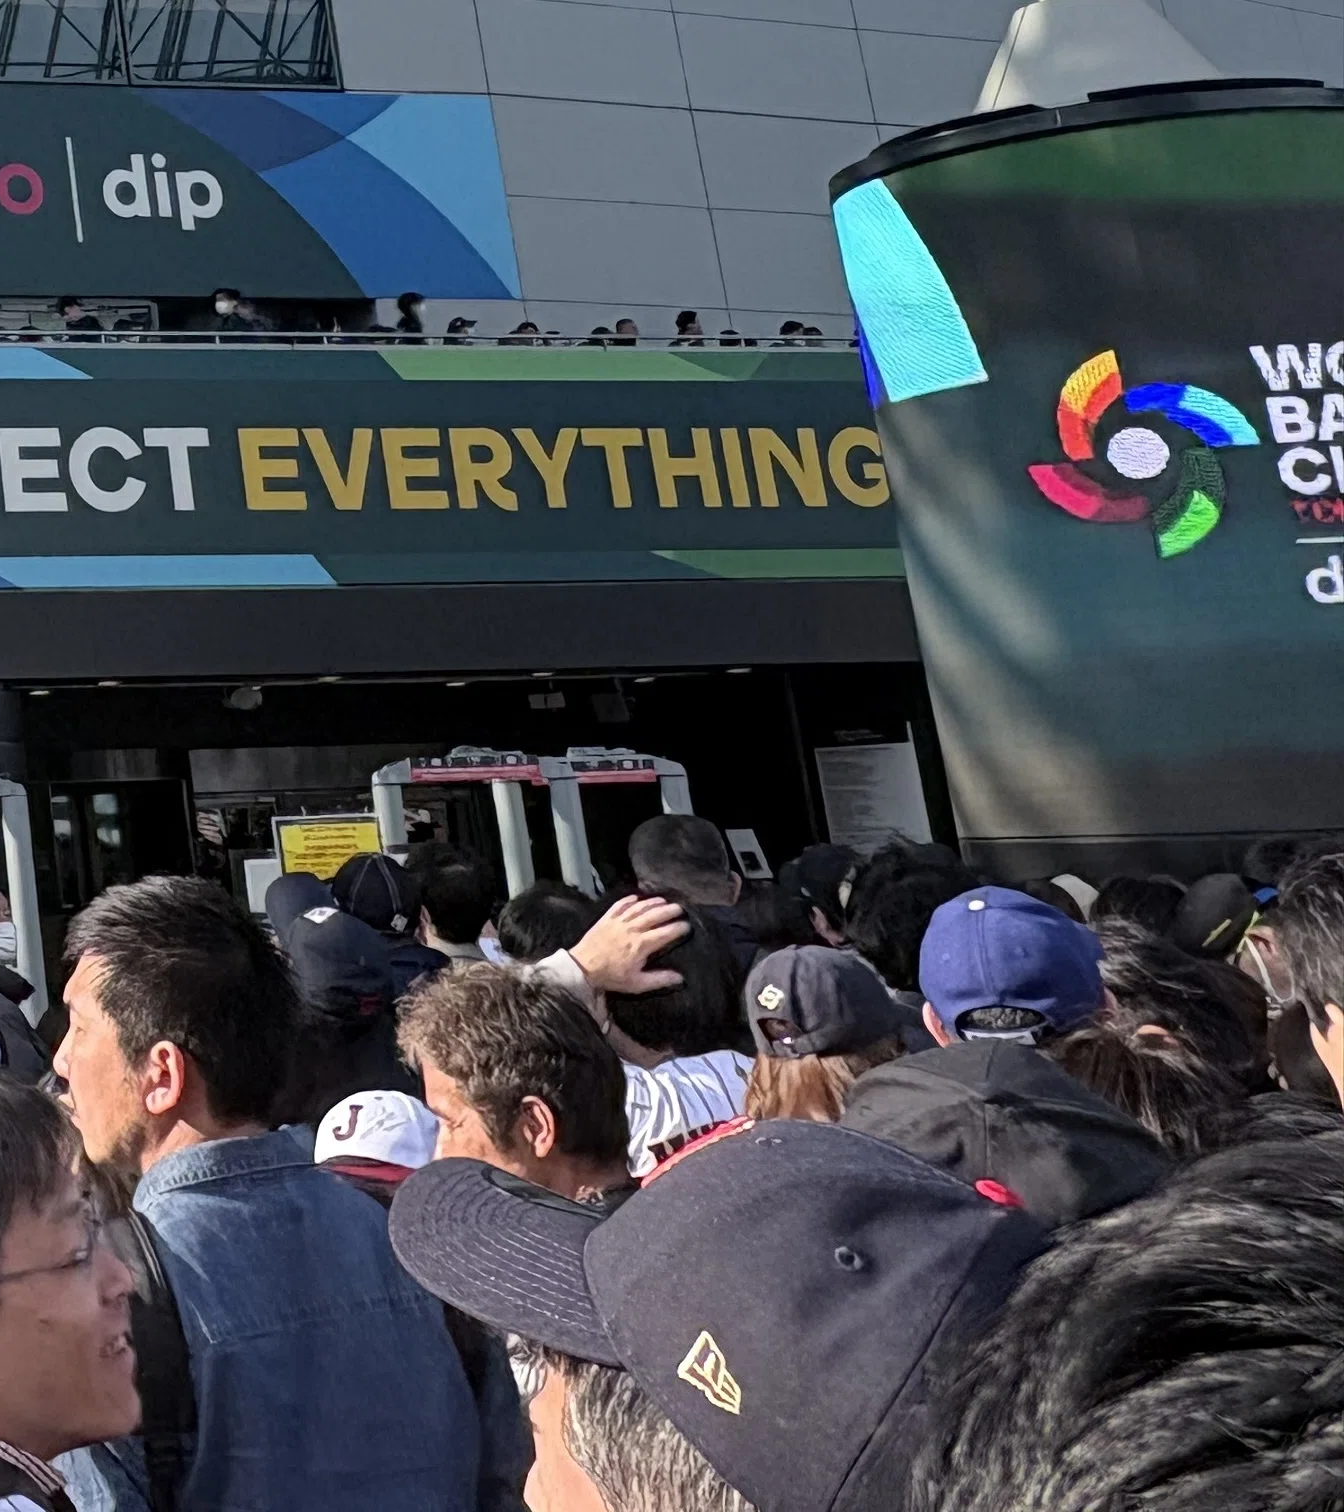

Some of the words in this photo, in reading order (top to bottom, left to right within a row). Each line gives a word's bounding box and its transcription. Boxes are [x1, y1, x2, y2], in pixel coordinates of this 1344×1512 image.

[102, 152, 224, 231] dip
[238, 425, 891, 511] EVERYTHING
[332, 1104, 364, 1142] J
